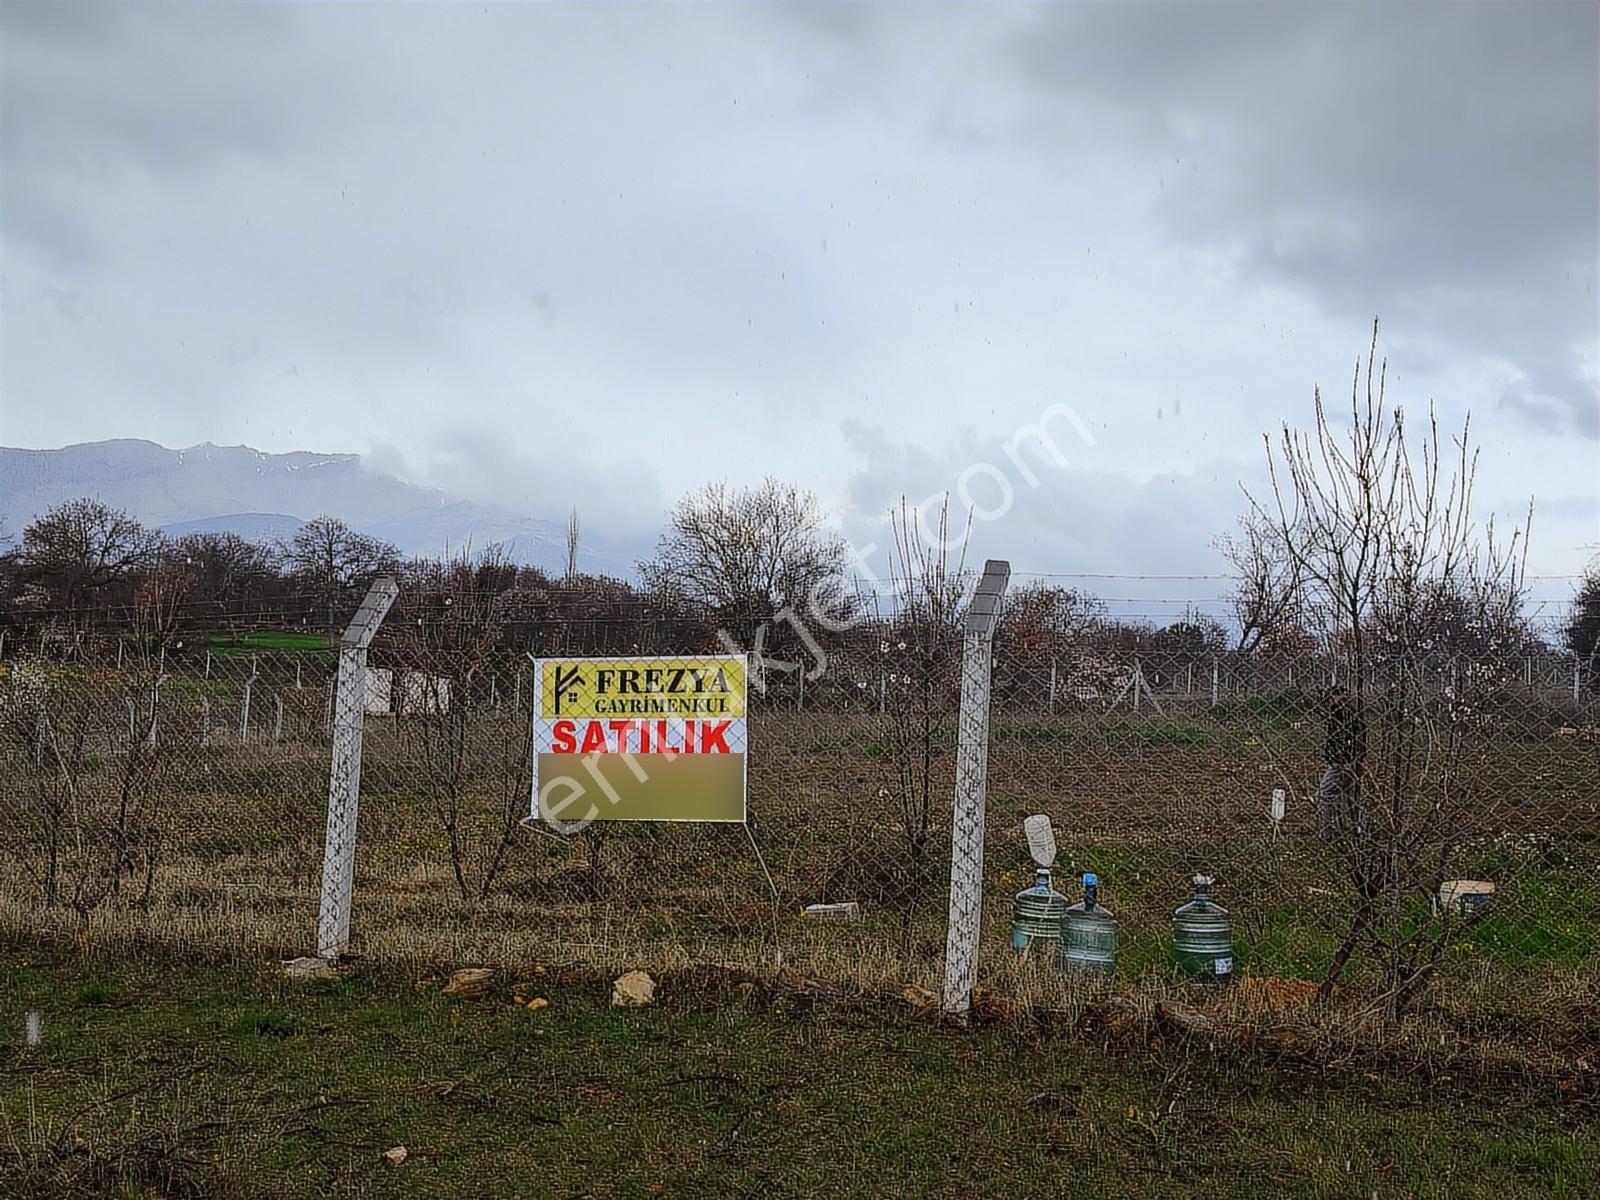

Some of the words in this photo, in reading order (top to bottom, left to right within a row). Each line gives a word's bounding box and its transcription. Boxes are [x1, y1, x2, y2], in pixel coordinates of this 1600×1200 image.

[595, 667, 732, 694] FREZYA
[595, 695, 731, 714] GAYRİMENKUL
[551, 720, 733, 753] SATILIK
